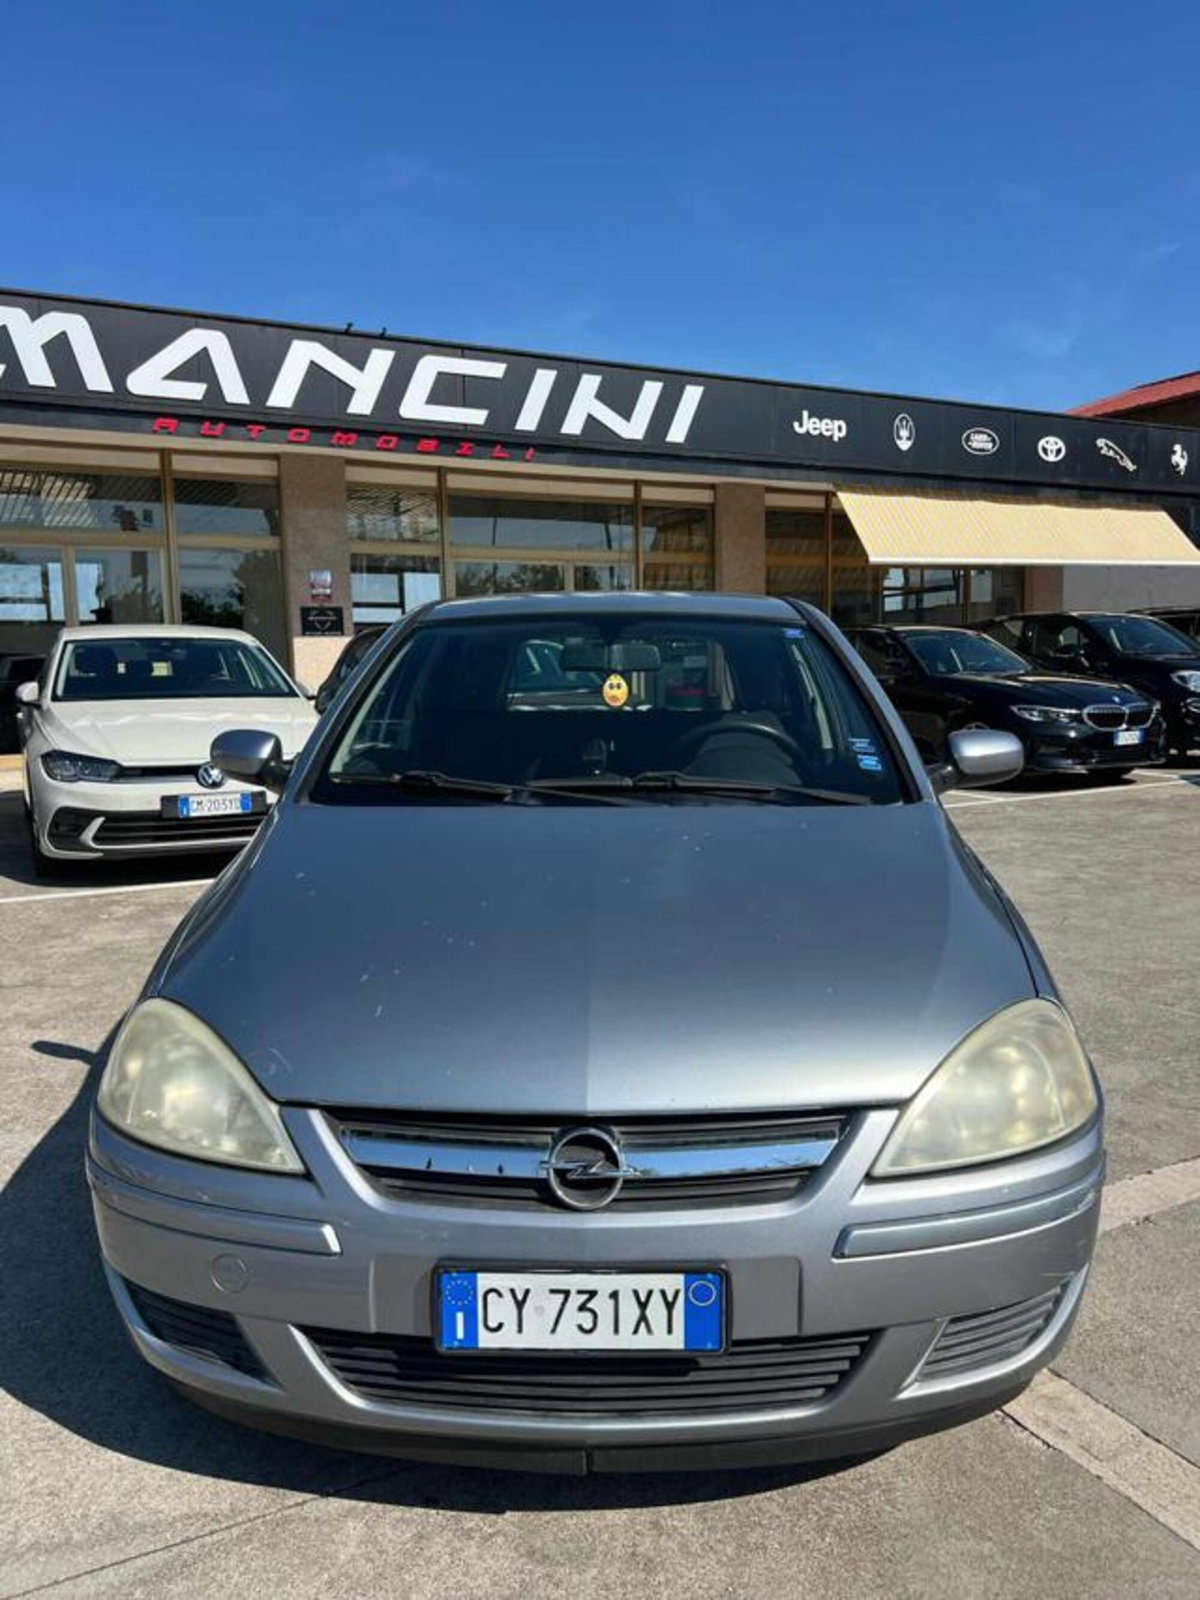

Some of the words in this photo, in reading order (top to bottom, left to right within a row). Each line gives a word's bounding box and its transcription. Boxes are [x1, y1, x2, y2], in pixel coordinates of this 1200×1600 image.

[0, 306, 704, 443] MANCINI
[152, 416, 534, 462] AUTOMOBILI
[793, 410, 847, 442] Jeep
[482, 1287, 531, 1334] CY
[549, 1288, 682, 1337] 731XY
